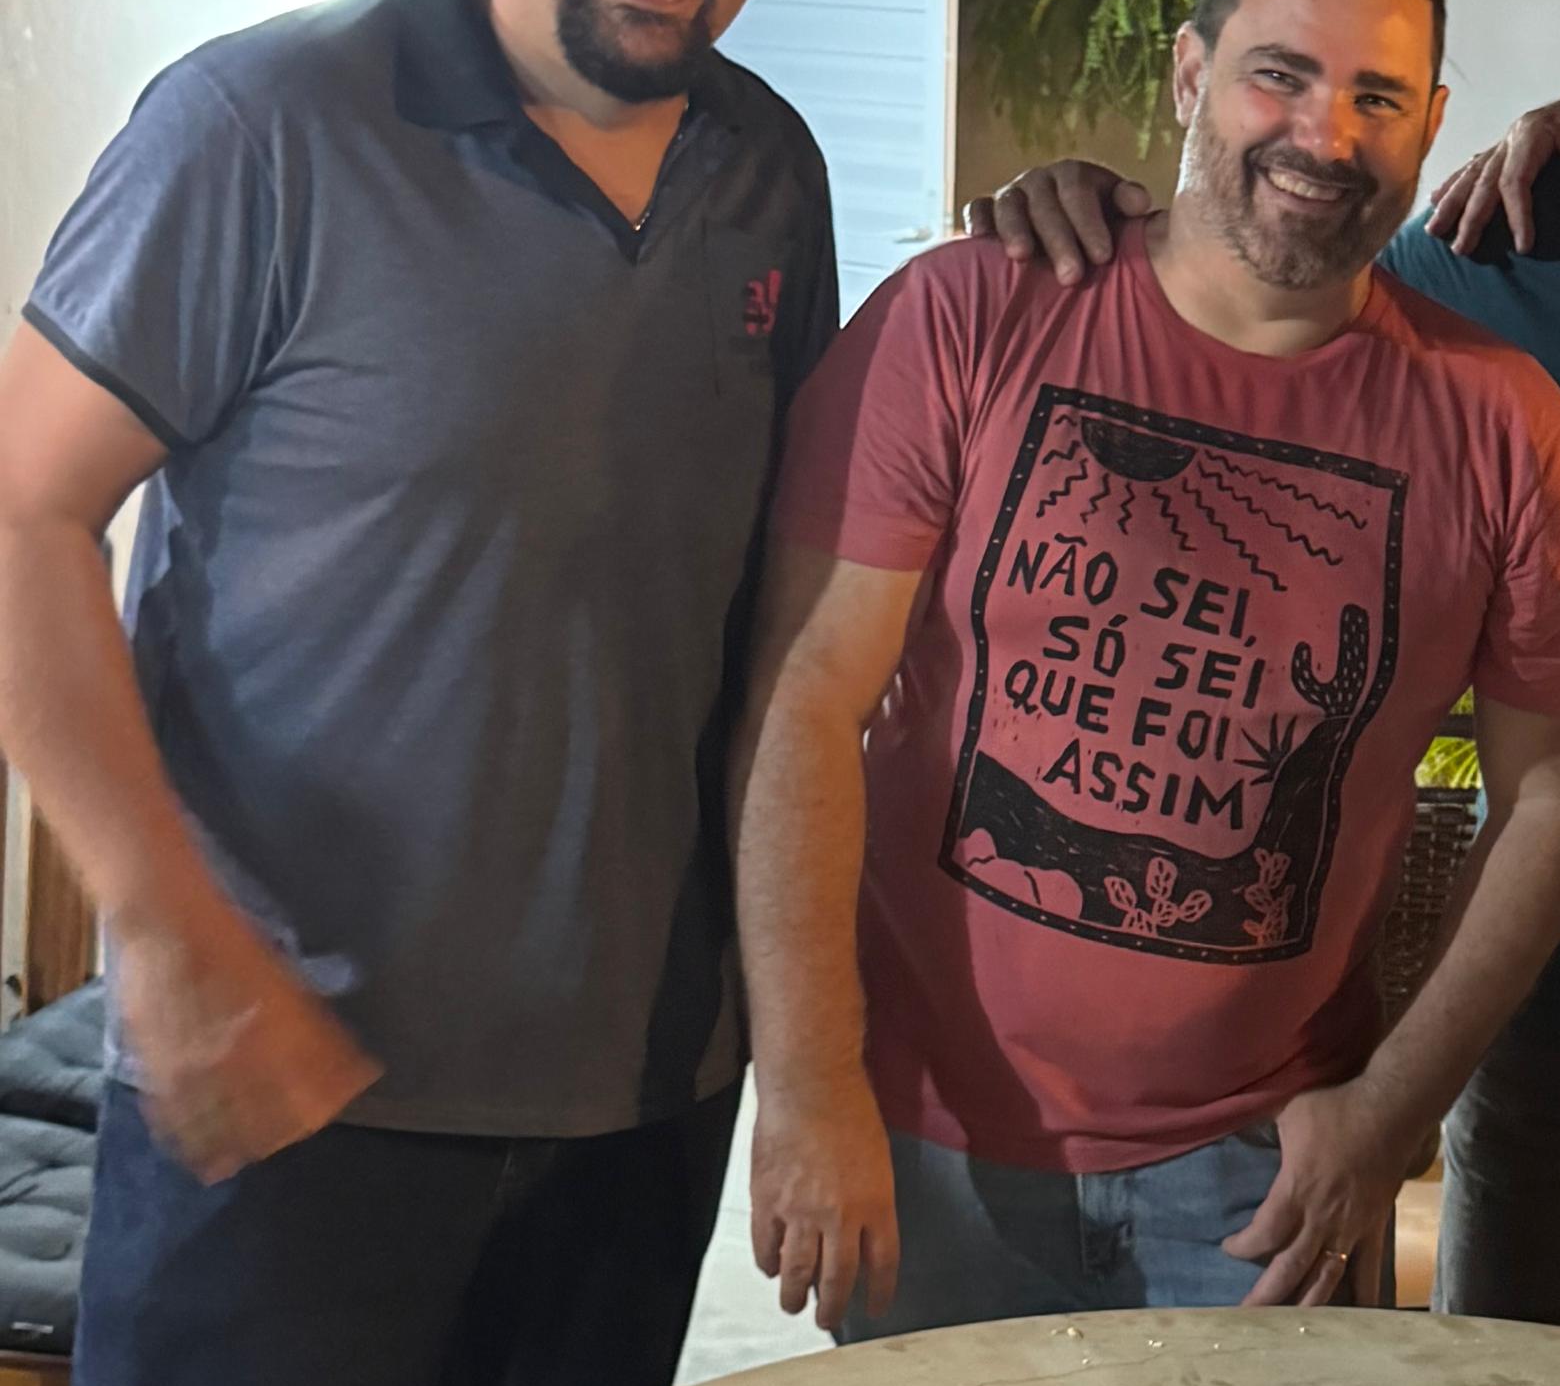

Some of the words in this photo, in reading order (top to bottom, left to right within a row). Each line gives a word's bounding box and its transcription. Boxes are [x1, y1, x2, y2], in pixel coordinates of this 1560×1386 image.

[1006, 532, 1119, 605] NÃO
[1139, 566, 1259, 649] SEI,
[1003, 658, 1116, 735] QUE
[1130, 697, 1229, 762] FOI
[1042, 613, 1126, 678] SÓ
[1154, 645, 1266, 710] SEI
[1042, 738, 1246, 831] ASSIM
